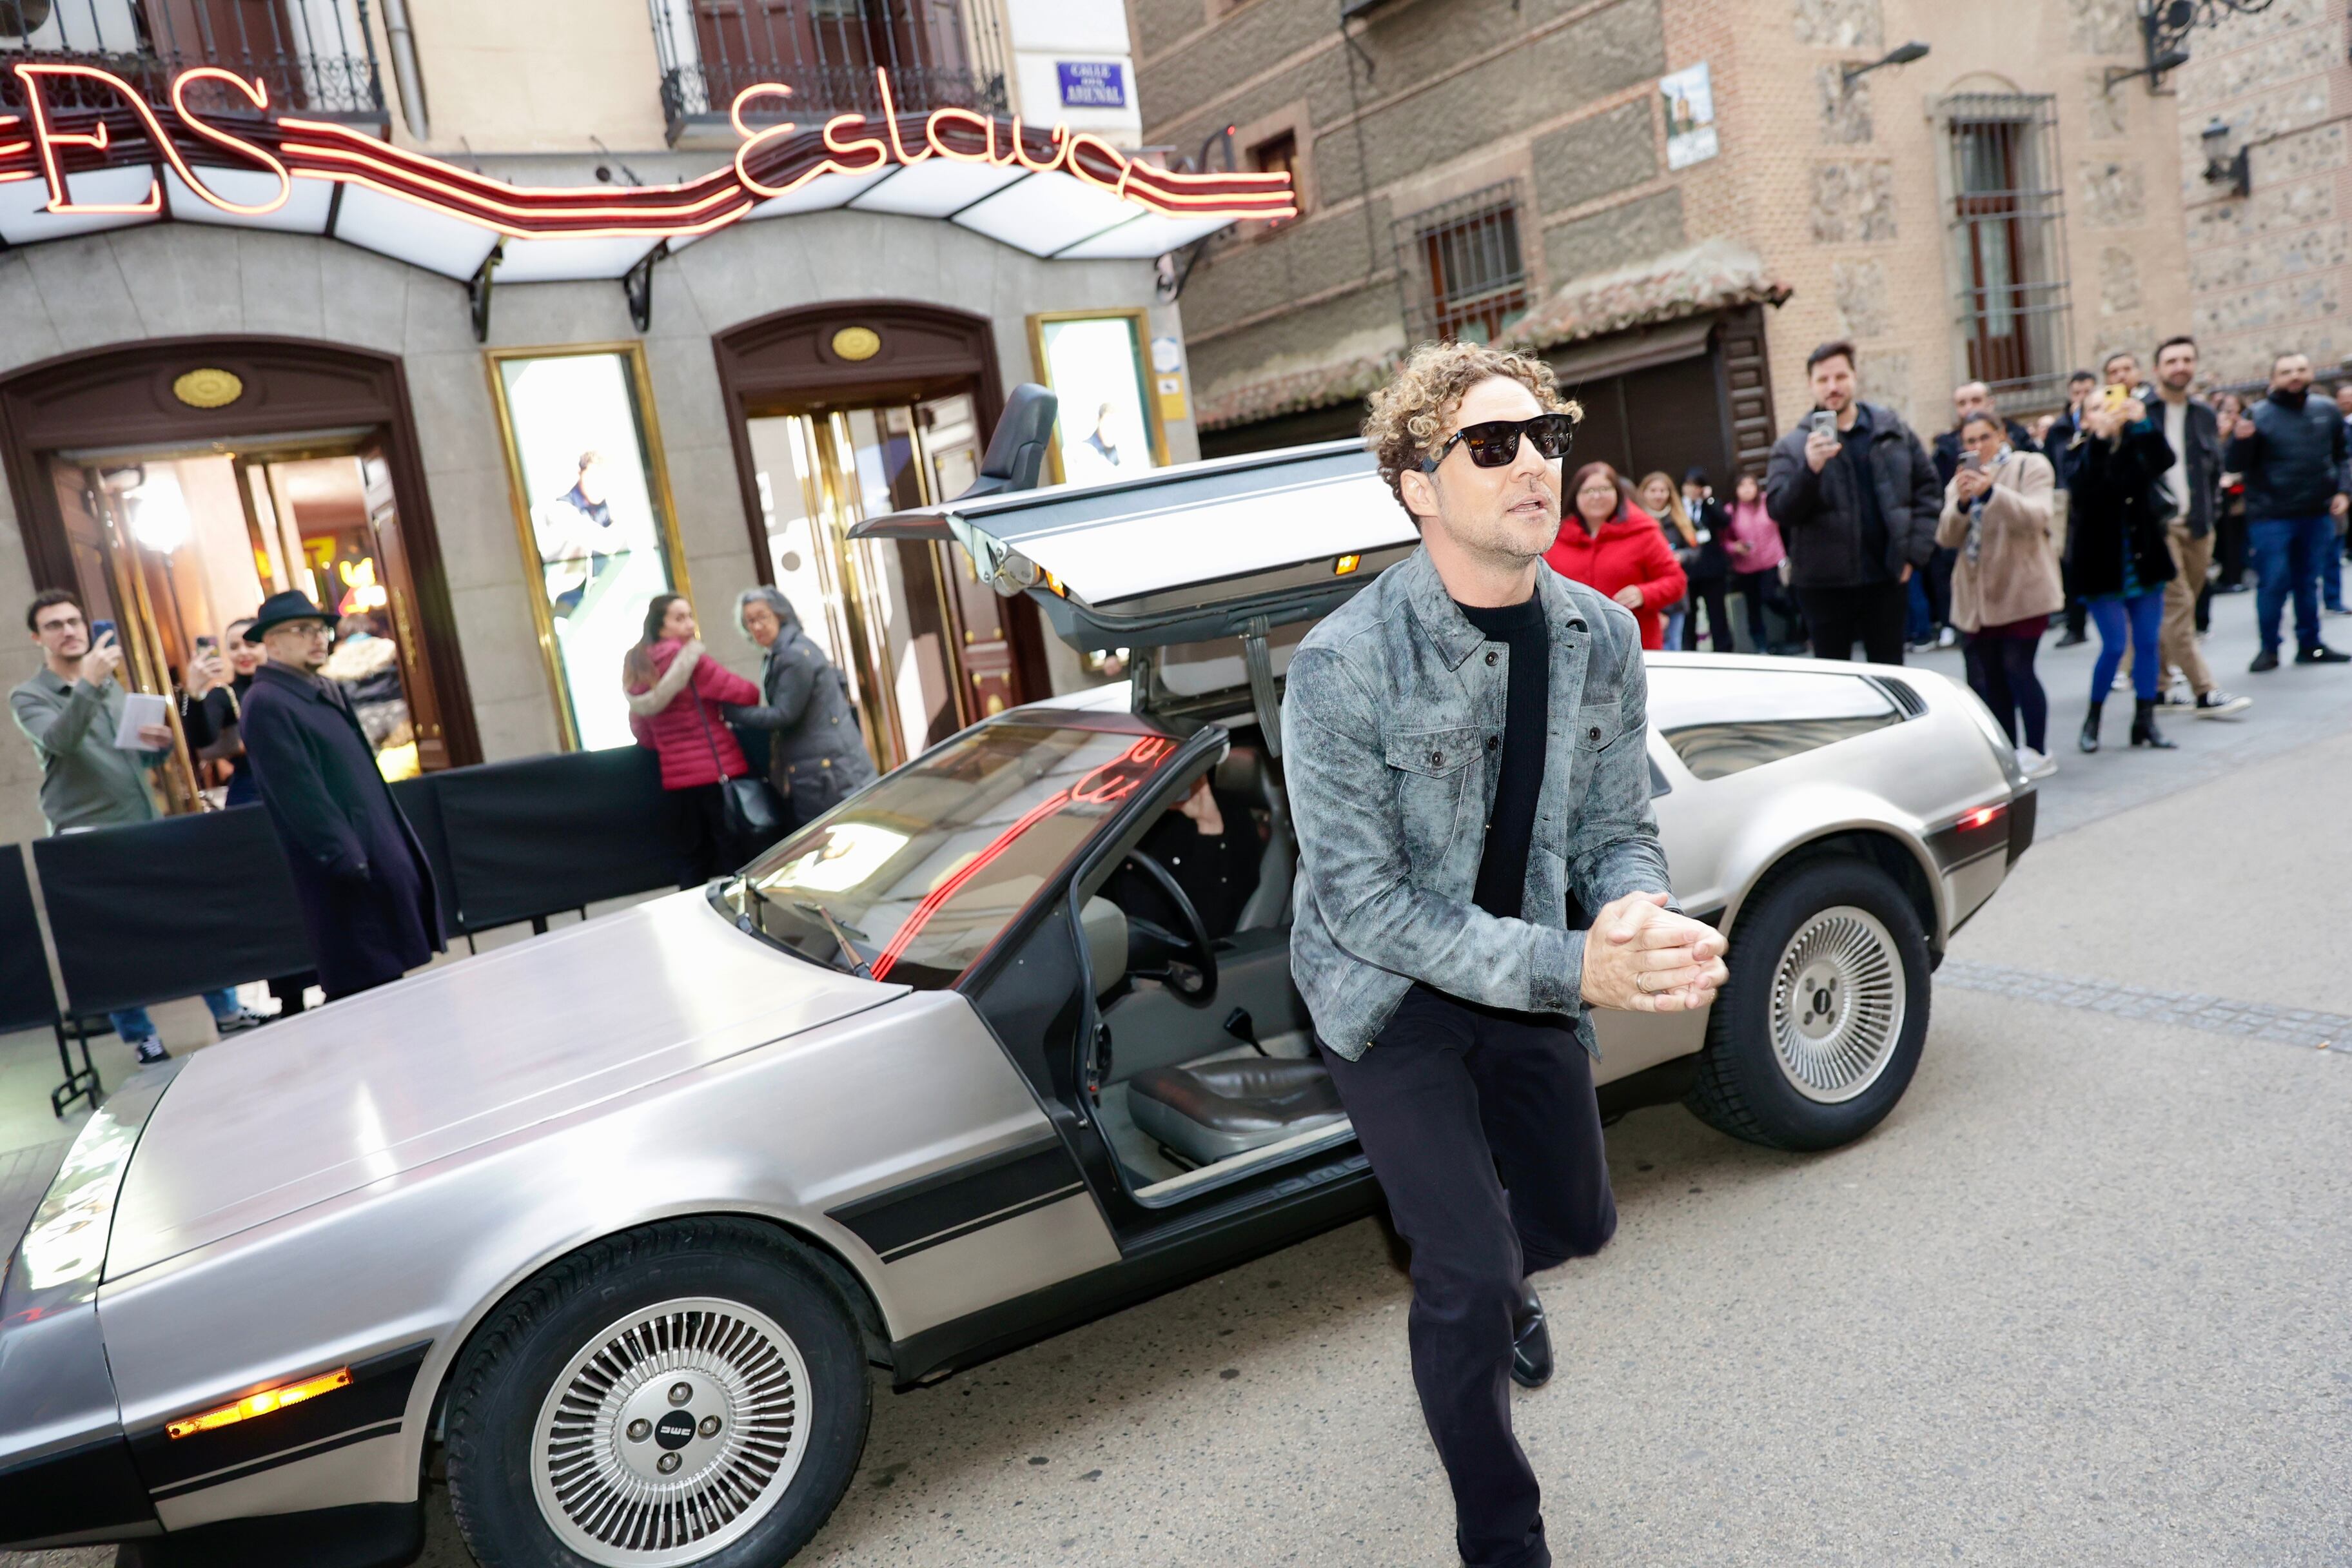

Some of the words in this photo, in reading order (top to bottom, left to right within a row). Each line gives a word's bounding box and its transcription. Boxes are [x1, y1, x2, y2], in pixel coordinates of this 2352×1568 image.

[1070, 64, 1112, 79] CALLE
[1066, 85, 1123, 104] ARENAL
[730, 66, 1133, 201] Eslava
